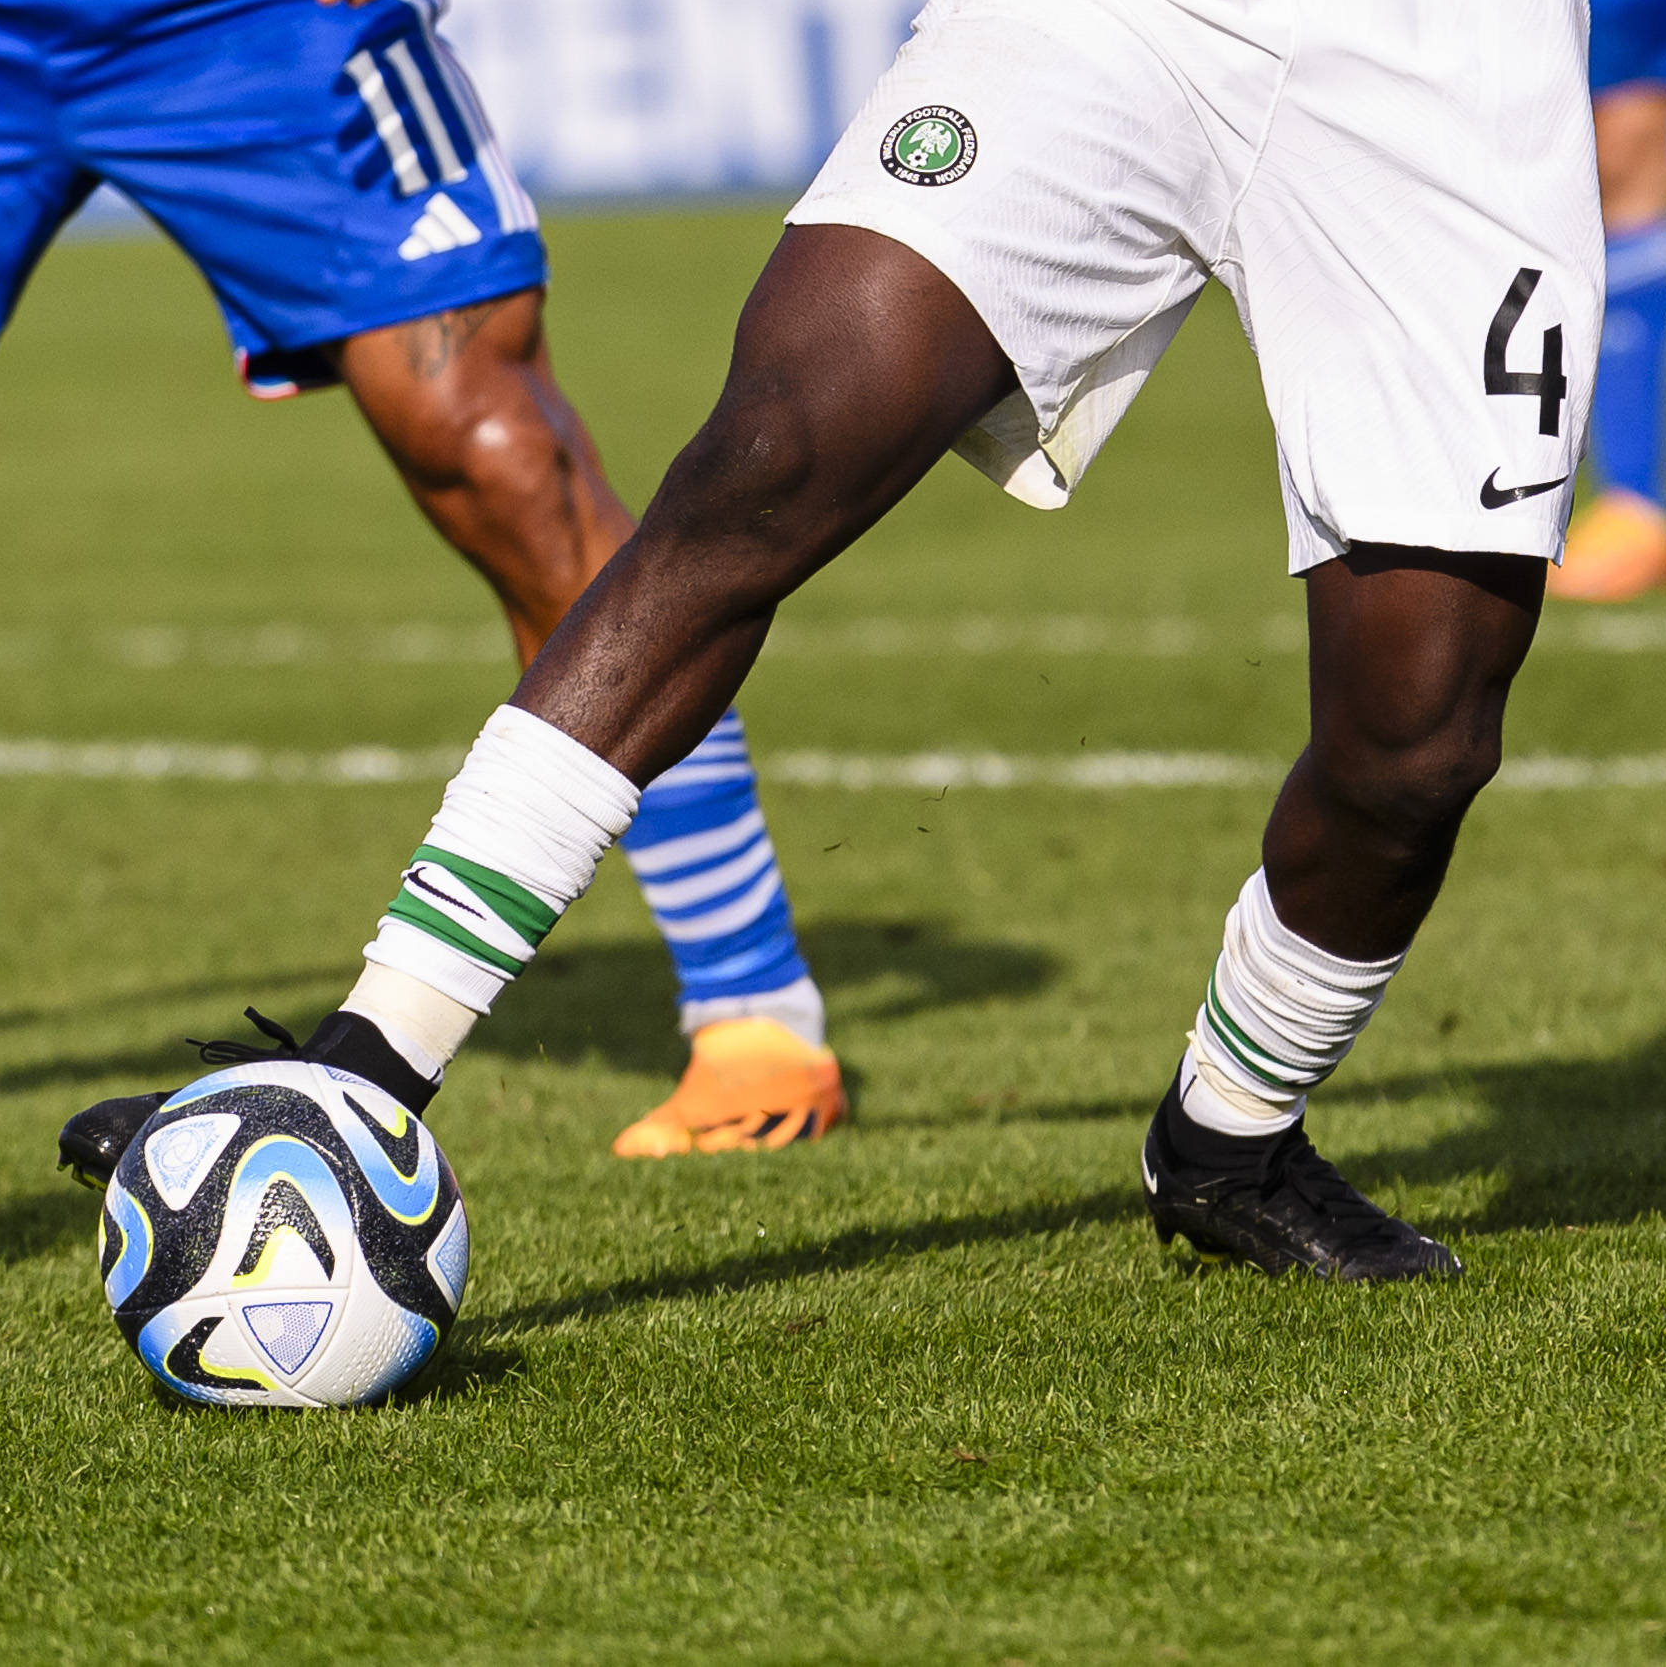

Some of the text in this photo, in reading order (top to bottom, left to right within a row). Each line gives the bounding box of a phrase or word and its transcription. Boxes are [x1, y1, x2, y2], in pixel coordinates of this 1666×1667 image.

[345, 38, 469, 194] 11
[905, 107, 965, 129] FOOTBALL
[935, 127, 975, 184] FEDERATION
[1484, 267, 1567, 437] 4
